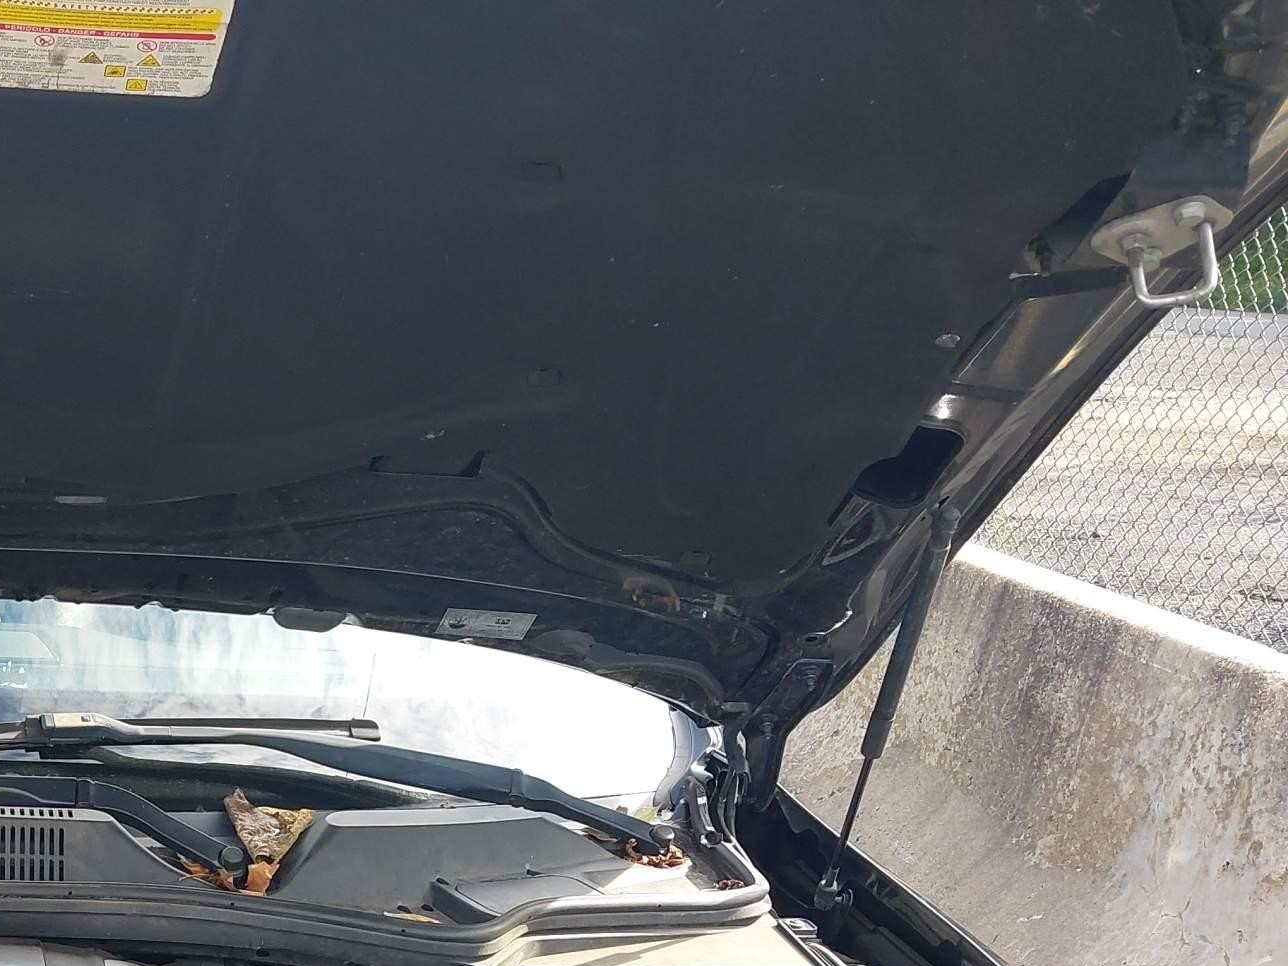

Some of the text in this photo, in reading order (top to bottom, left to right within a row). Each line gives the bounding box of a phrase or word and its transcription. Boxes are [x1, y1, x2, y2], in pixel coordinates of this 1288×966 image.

[53, 3, 98, 11] SAFETY
[4, 24, 51, 33] PERICOLO
[58, 28, 97, 36] DANGER
